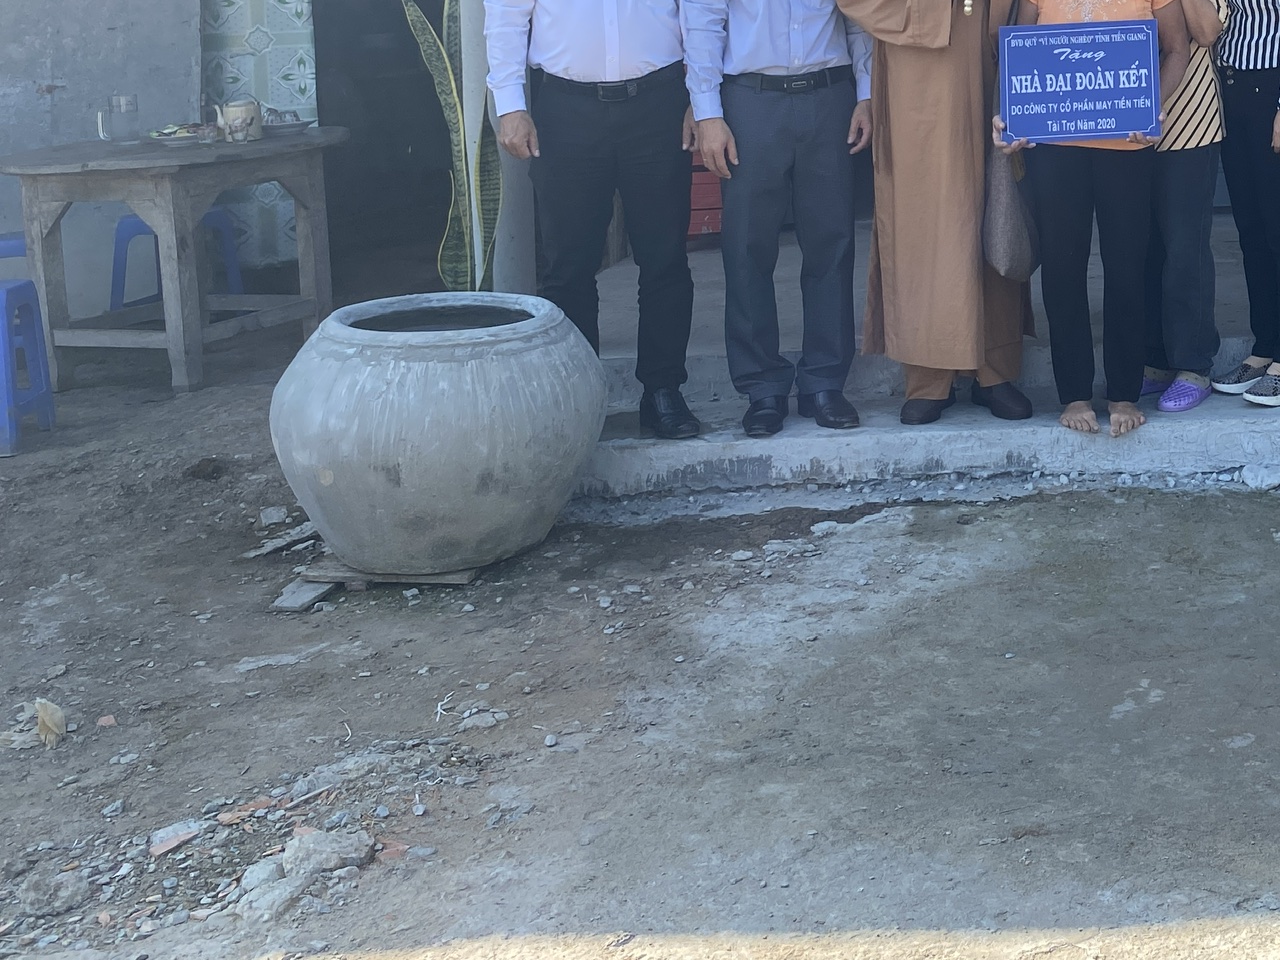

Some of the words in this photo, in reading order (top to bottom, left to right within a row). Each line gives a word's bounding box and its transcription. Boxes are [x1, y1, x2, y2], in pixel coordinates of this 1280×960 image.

[1127, 32, 1147, 42] GIANG
[1053, 48, 1107, 62] Tặng
[1011, 69, 1042, 93] NHÀ
[1045, 72, 1072, 95] ĐẠI
[1075, 66, 1115, 91] ĐOÀN
[1119, 60, 1149, 88] KẾT
[1011, 105, 1022, 115] DO
[1024, 103, 1047, 114] CÔNG
[1048, 103, 1058, 113] TY
[1060, 98, 1071, 113] CỔ
[1096, 100, 1112, 111] MAY
[1047, 120, 1060, 132] Tài
[1061, 120, 1076, 133] Trợ
[1077, 119, 1096, 131] Năm
[1097, 118, 1116, 129] 2020
